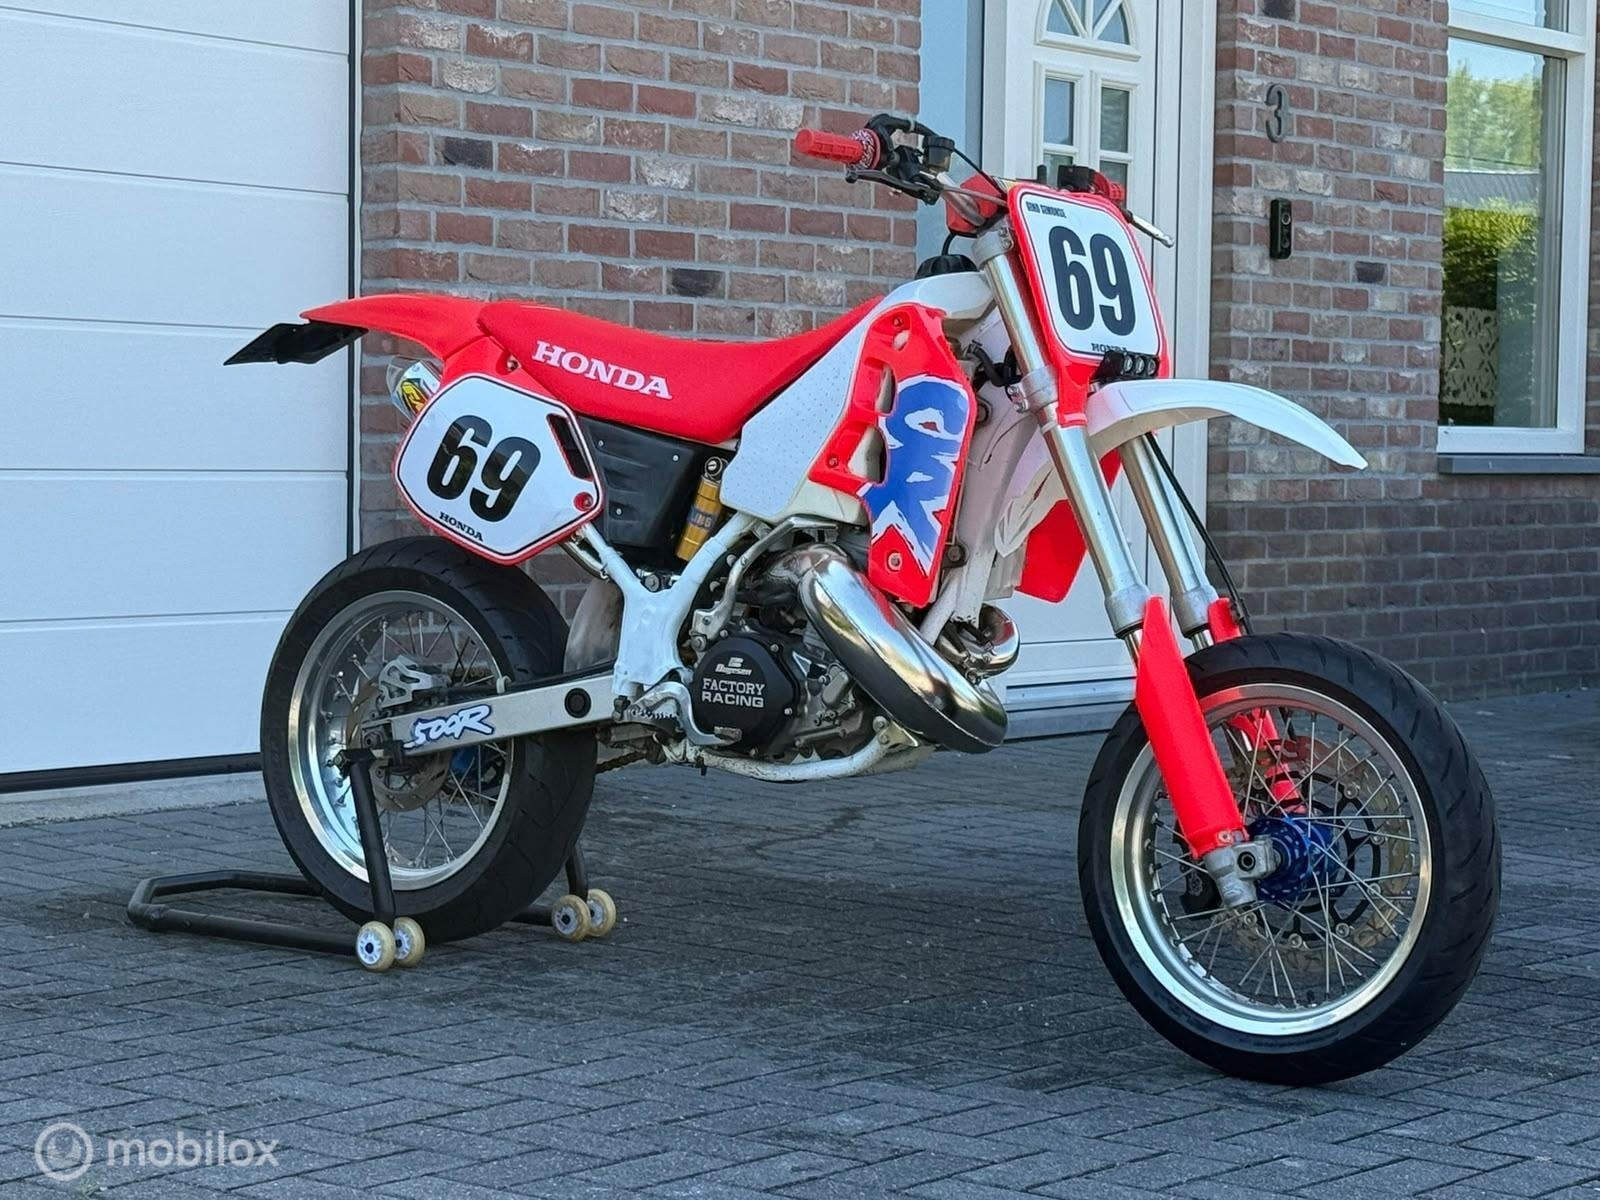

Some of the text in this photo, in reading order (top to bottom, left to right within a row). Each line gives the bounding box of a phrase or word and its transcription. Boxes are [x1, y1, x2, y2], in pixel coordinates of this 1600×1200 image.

[1265, 84, 1290, 143] 3
[1049, 225, 1136, 336] 69
[531, 340, 673, 400] HONDA
[427, 415, 541, 523] 69
[439, 511, 484, 542] HONDA
[701, 690, 764, 709] RACING
[702, 678, 765, 696] FACTORY
